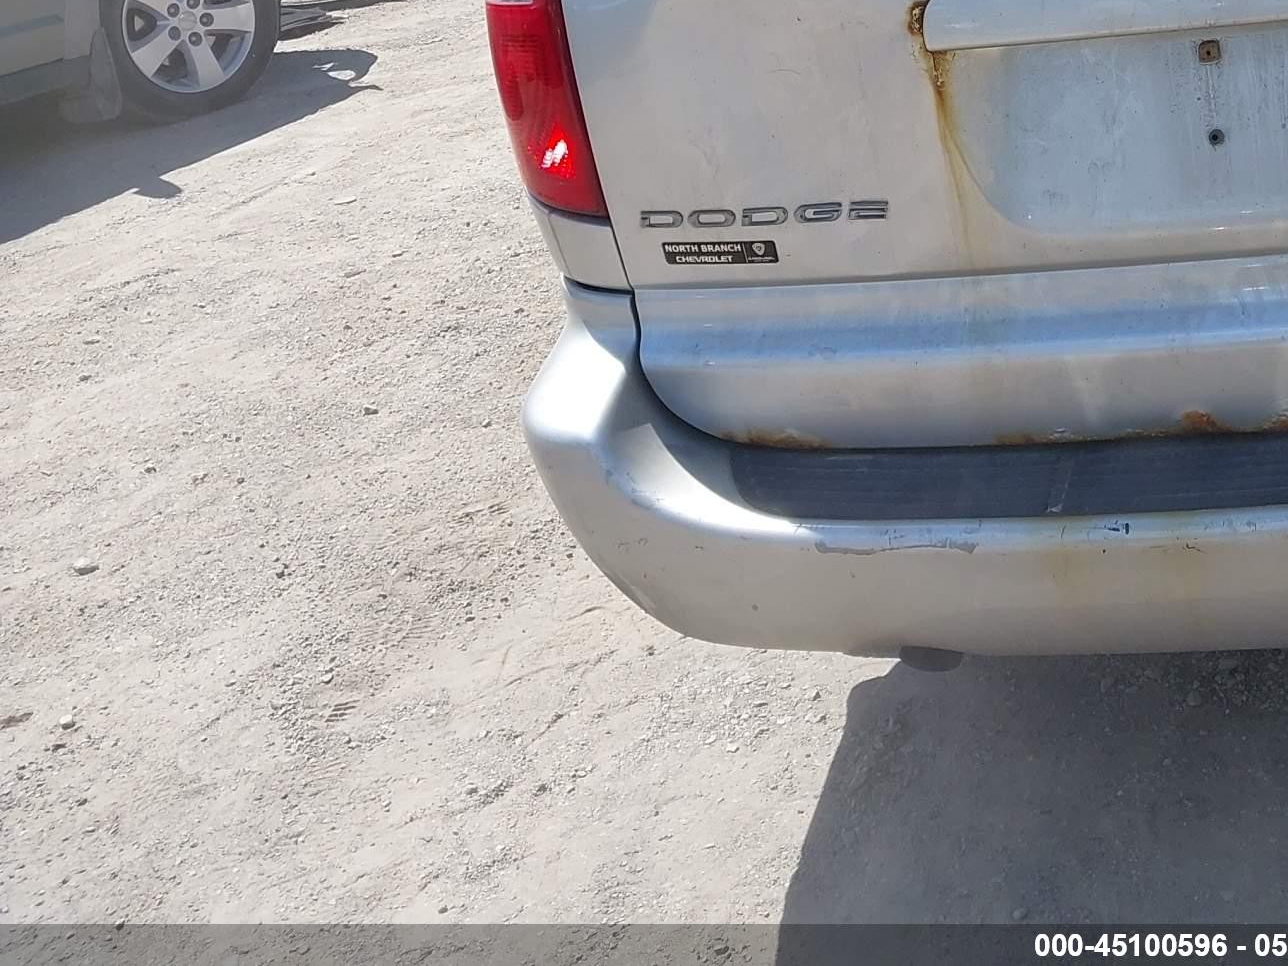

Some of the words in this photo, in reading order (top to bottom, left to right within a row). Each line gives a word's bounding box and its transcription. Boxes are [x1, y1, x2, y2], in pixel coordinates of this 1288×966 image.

[639, 200, 889, 228] DODGE
[664, 244, 699, 253] NORTH
[700, 243, 742, 253] BRANCH
[675, 255, 734, 263] CHEVROLET
